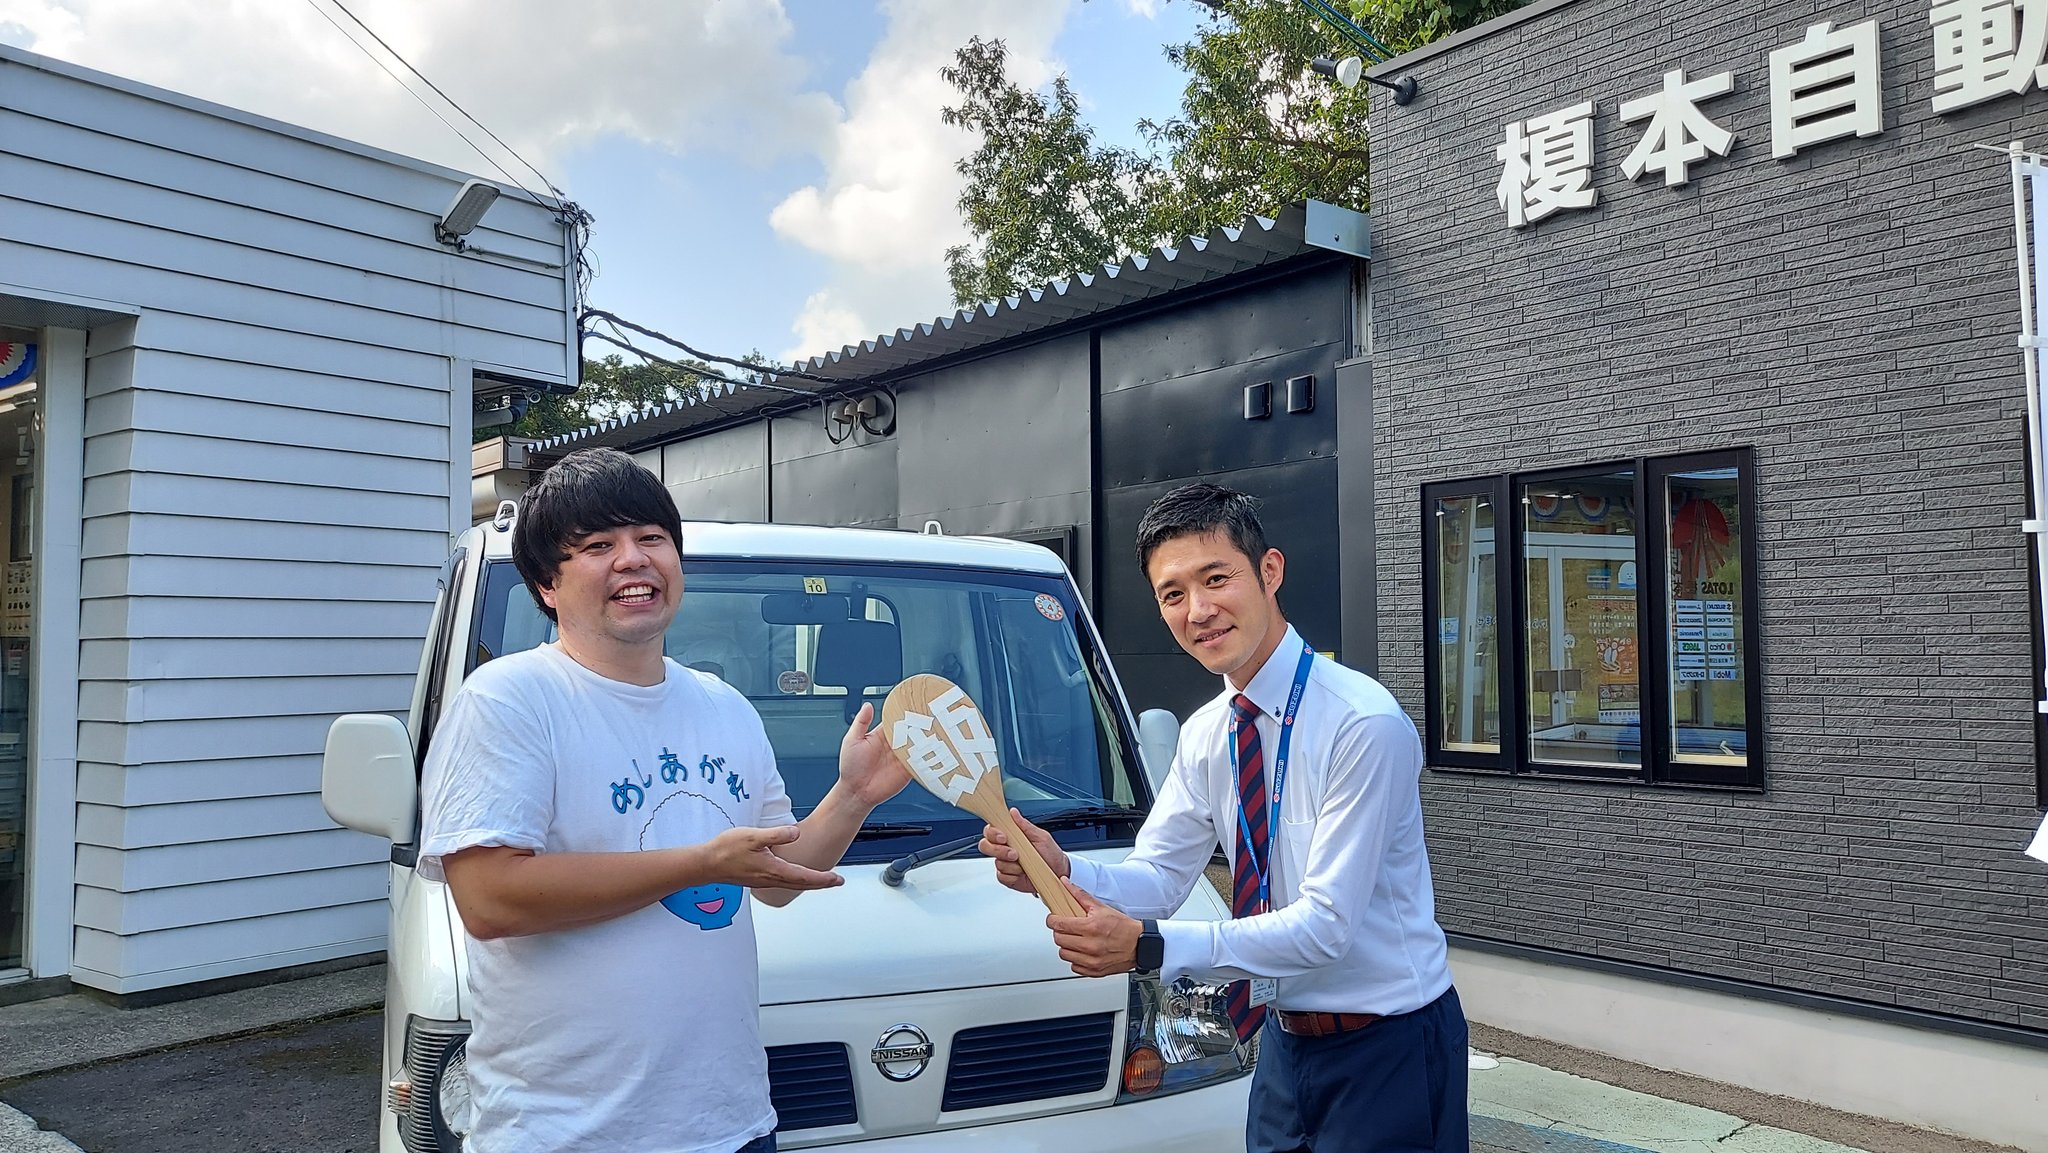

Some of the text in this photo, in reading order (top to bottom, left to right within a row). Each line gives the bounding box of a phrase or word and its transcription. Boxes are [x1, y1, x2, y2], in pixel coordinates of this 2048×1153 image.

[1496, 0, 2048, 228] 榎本自動
[808, 584, 823, 593] 10
[892, 686, 998, 807] 飯
[609, 747, 750, 814] めしあがれ
[879, 1047, 928, 1060] NISSAN
